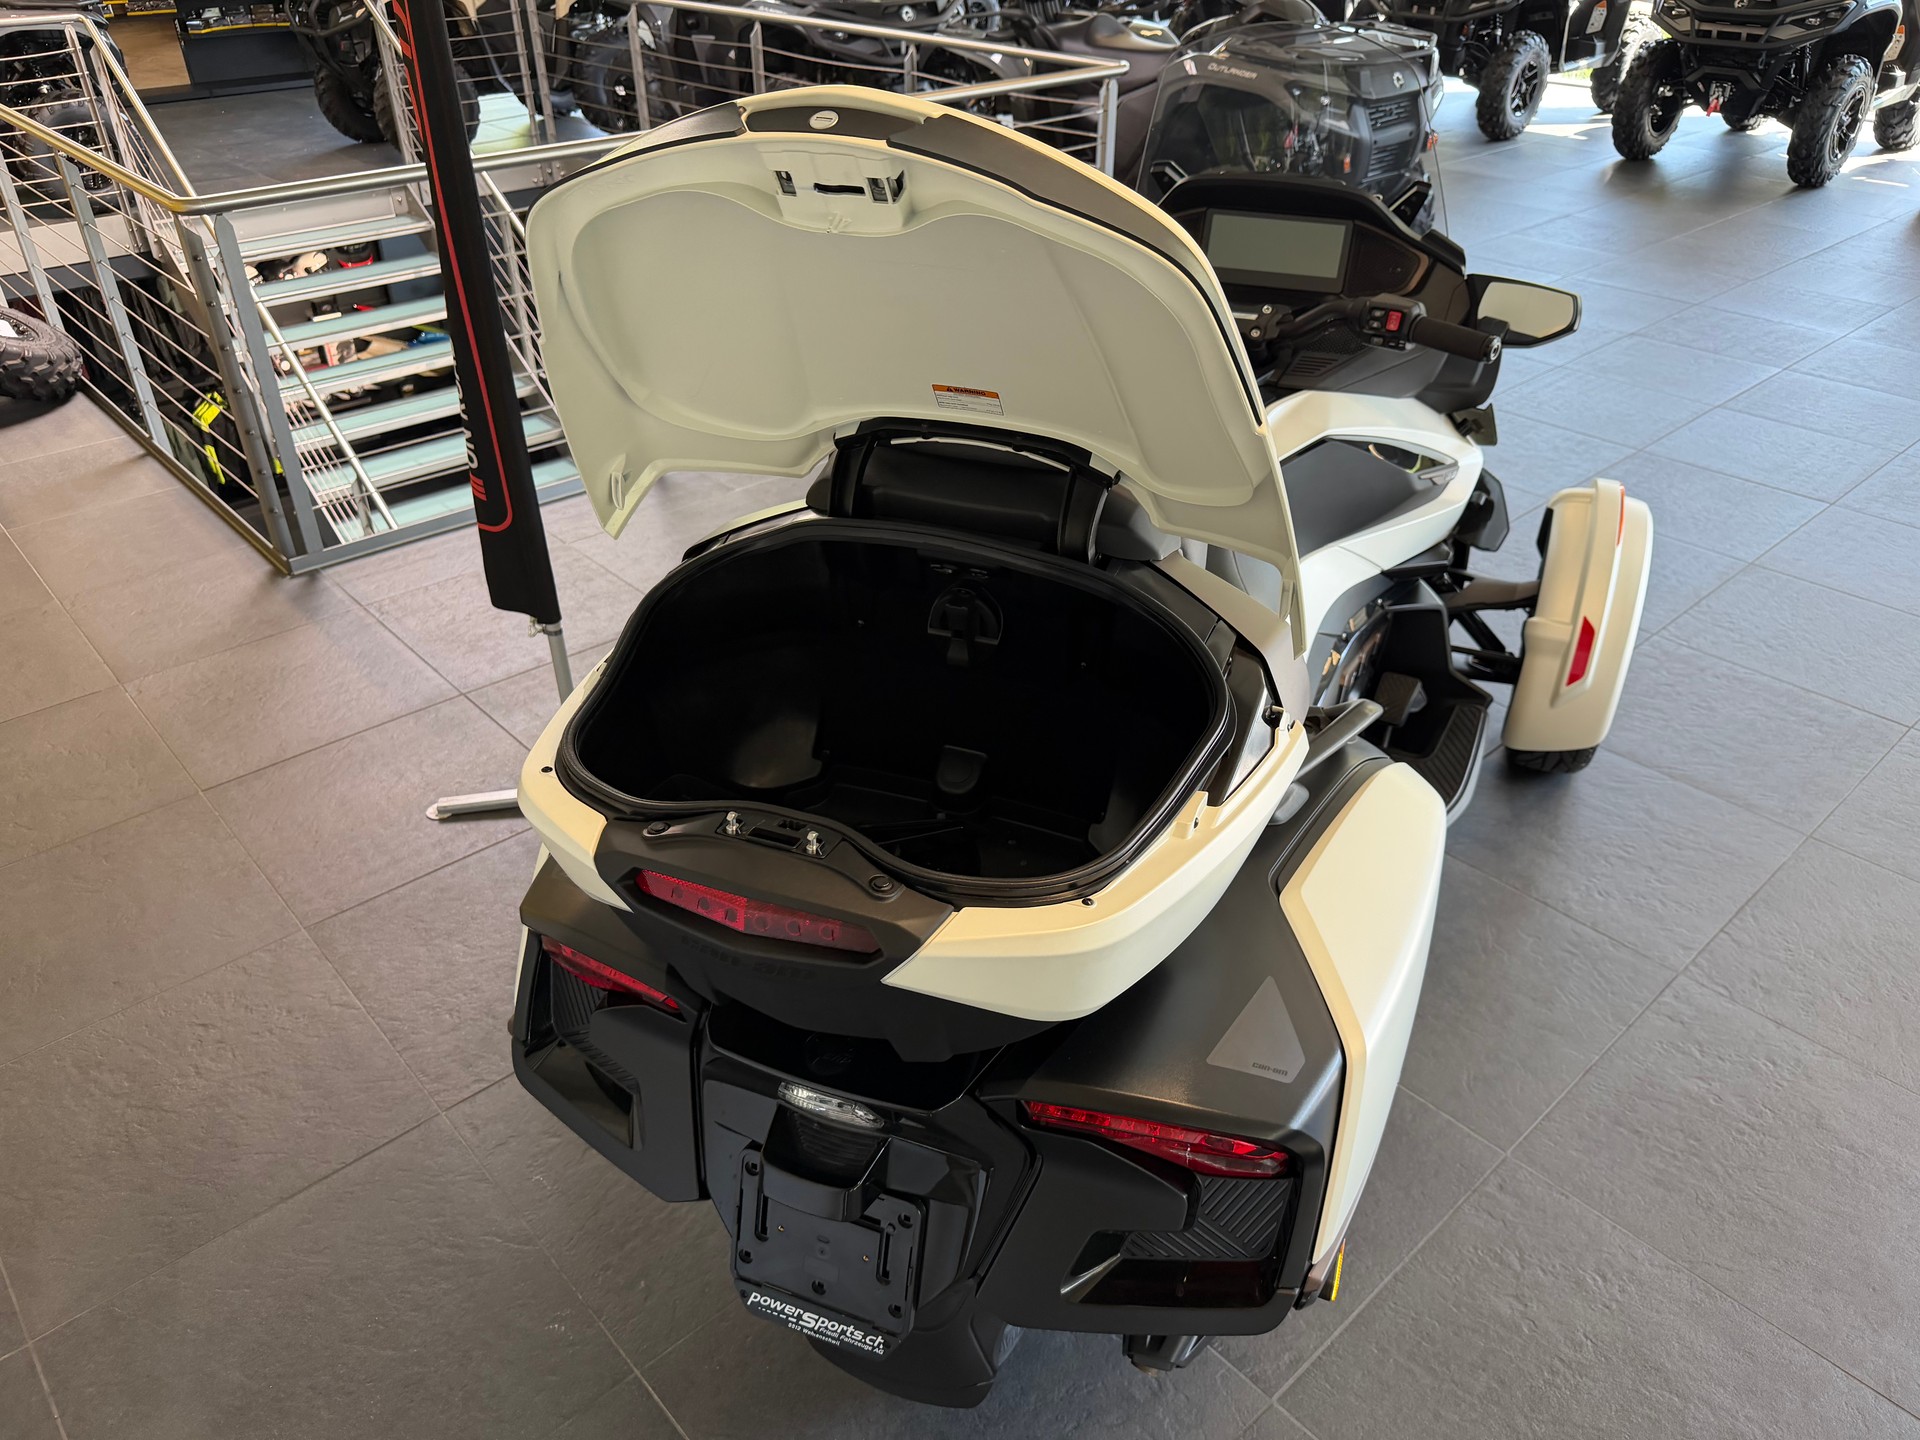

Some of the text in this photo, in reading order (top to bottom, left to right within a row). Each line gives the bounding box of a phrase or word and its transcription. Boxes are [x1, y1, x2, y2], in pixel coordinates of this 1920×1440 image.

[1208, 63, 1257, 79] OUTLANDER
[953, 387, 987, 396] WARNING
[840, 1334, 873, 1351] Fahrzeuge
[873, 1347, 885, 1355] AG
